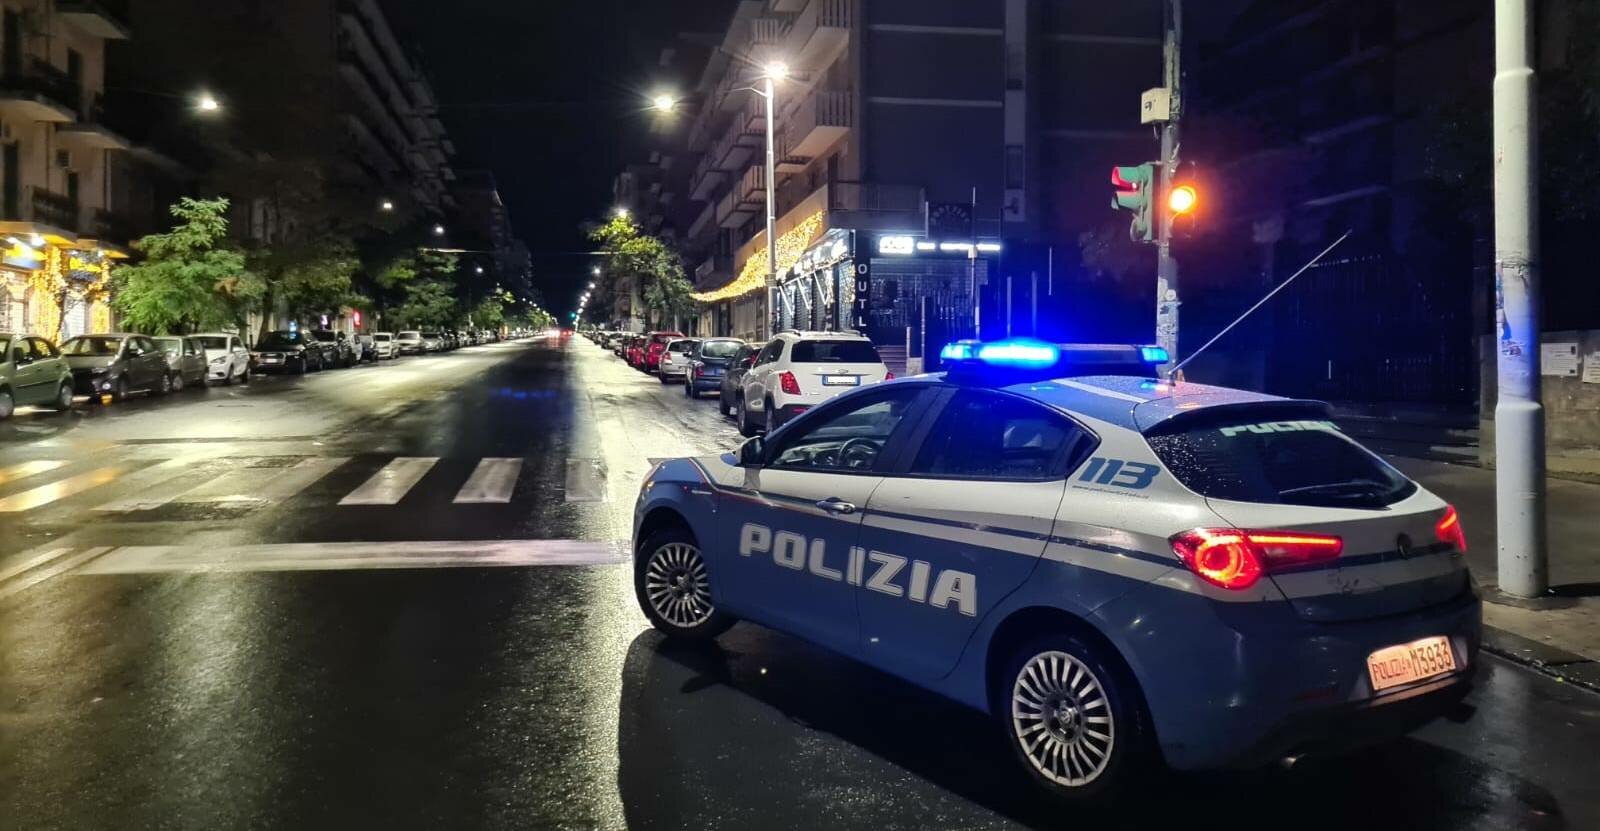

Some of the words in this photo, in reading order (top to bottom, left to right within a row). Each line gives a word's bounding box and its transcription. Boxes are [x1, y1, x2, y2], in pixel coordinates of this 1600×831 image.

[857, 263, 868, 336] OUTL
[1078, 457, 1161, 489] 113
[739, 522, 977, 617] POLIZIA
[1371, 656, 1408, 681] POLIZIA
[1409, 641, 1452, 676] M3933
